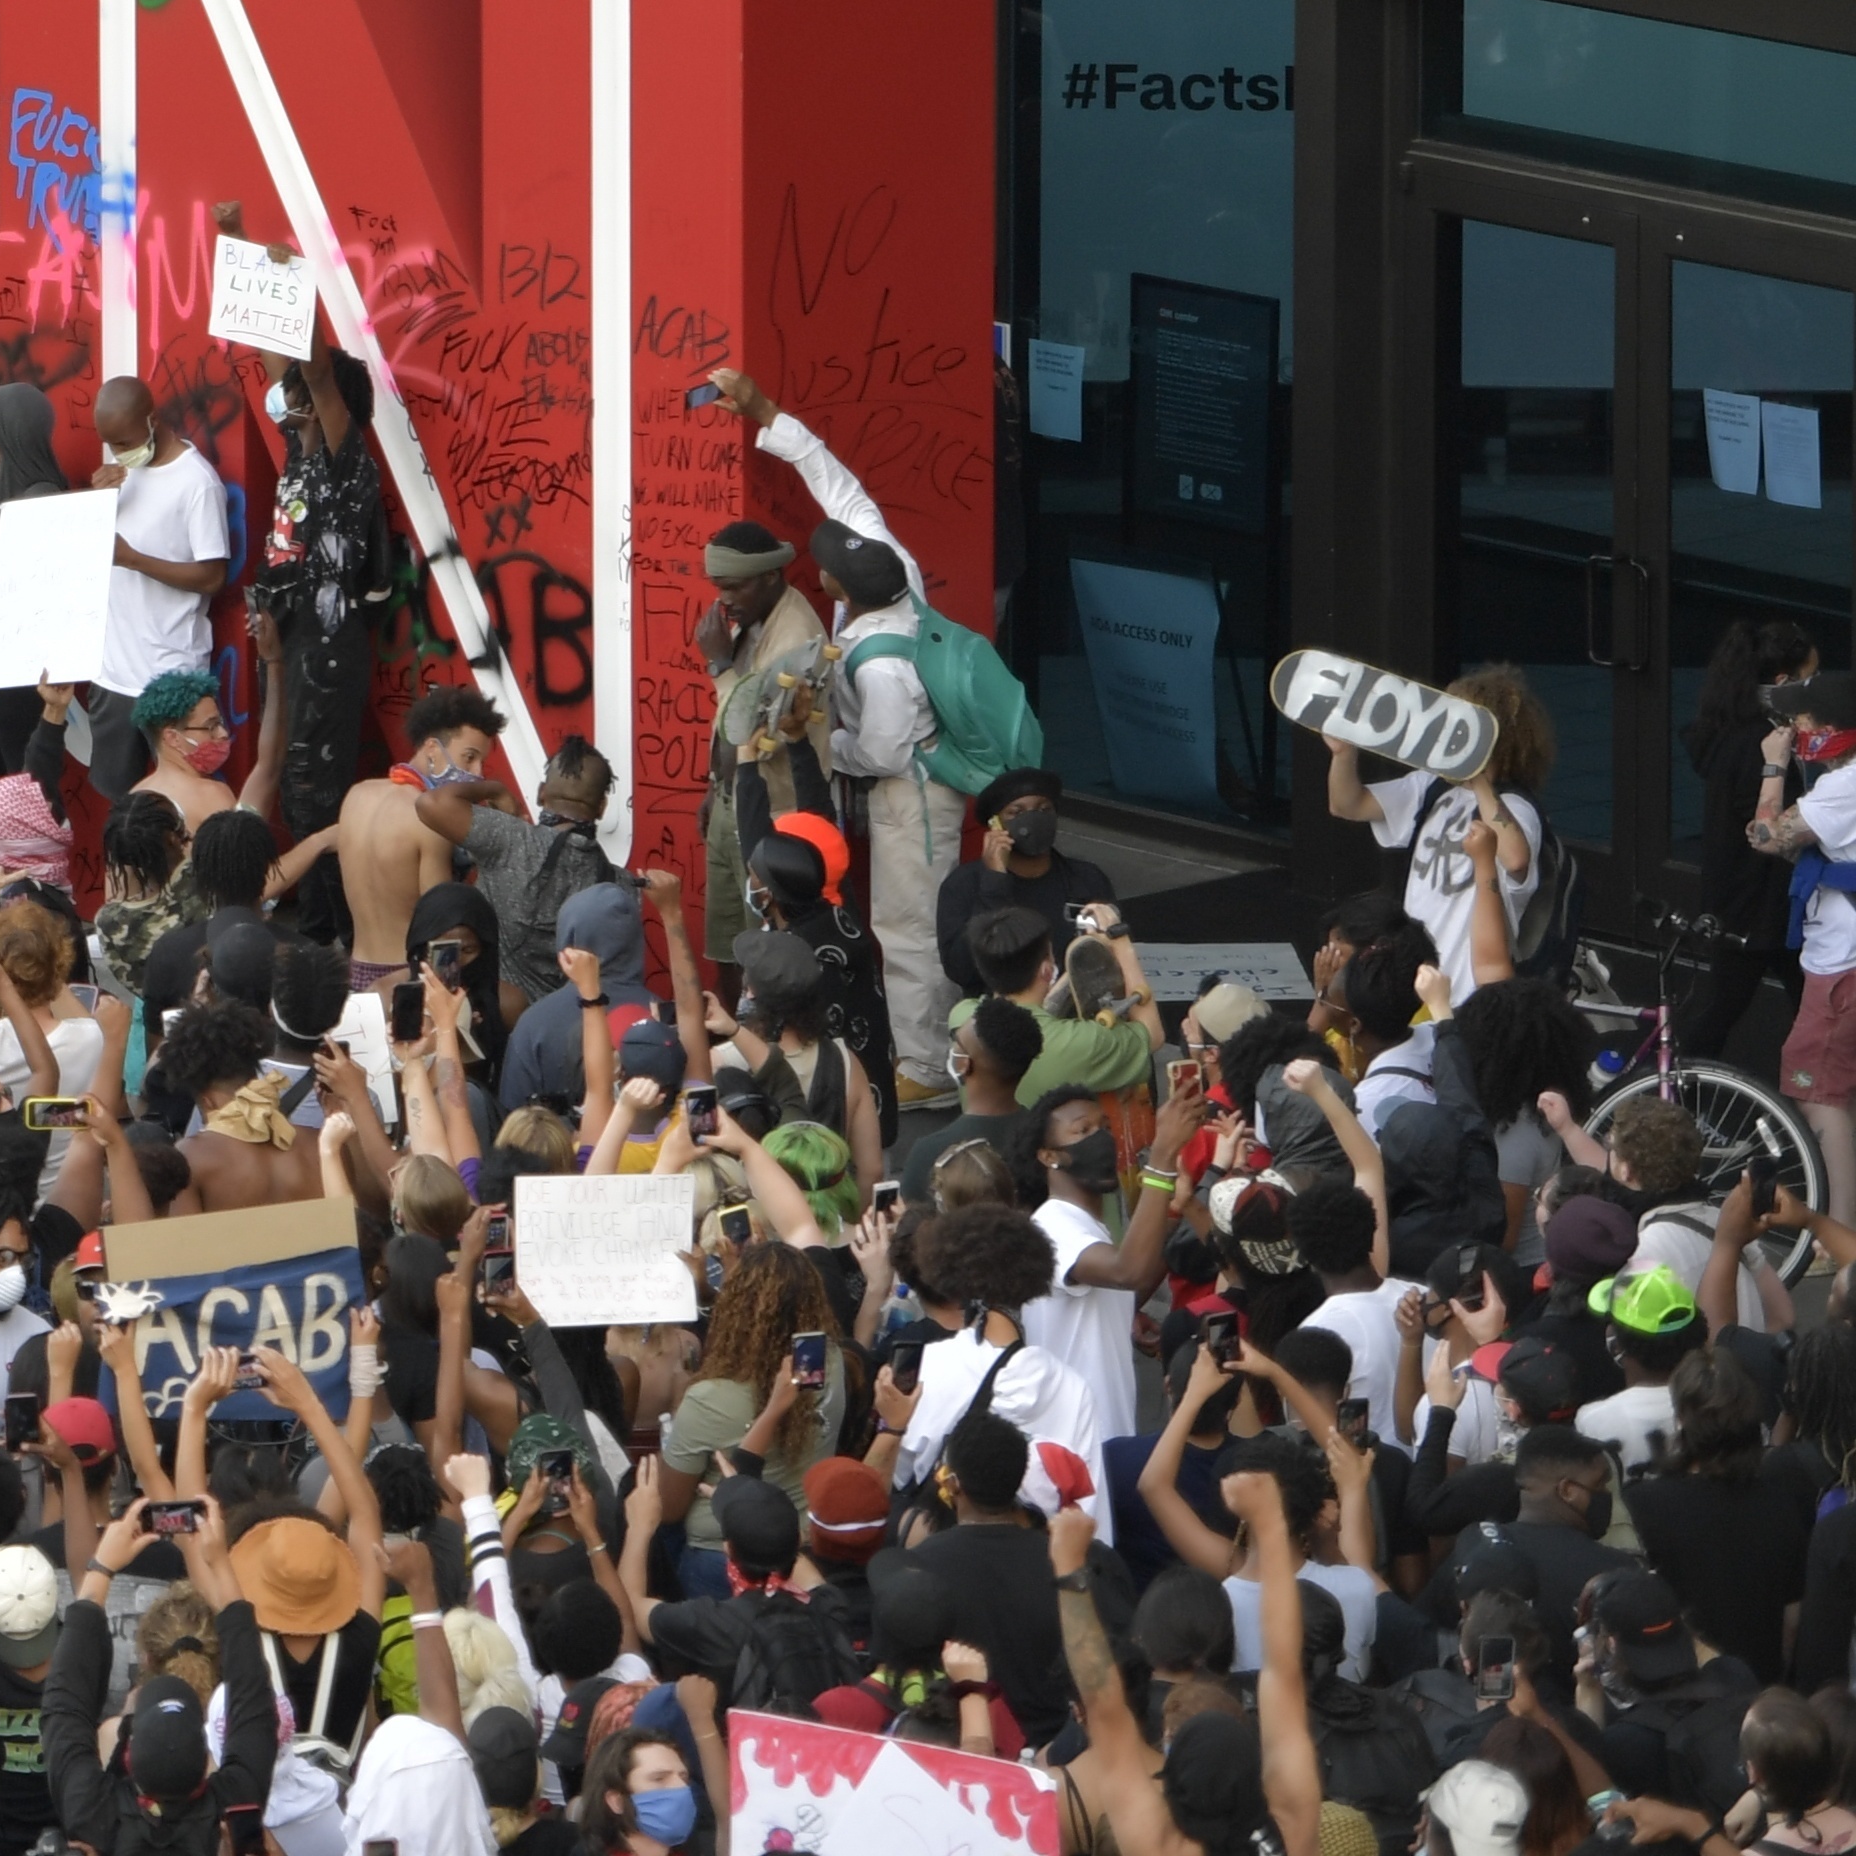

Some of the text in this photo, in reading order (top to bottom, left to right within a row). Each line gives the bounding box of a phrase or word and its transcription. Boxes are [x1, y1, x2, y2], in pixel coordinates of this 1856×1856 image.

[9, 88, 104, 175] FUCK
[225, 243, 303, 284] BLACK
[768, 183, 897, 317] NO
[230, 275, 298, 306] LIVES
[220, 302, 311, 344] MATTER!
[634, 295, 730, 377] ACAB
[440, 321, 528, 382] FUCK
[633, 431, 691, 471] TURN
[656, 484, 691, 508] WILL
[692, 481, 741, 517] MAKE
[1114, 622, 1156, 643] ACCESS
[1159, 630, 1193, 649] ONLY
[1286, 651, 1482, 771] FLOYD
[134, 1273, 347, 1378] ACAB
